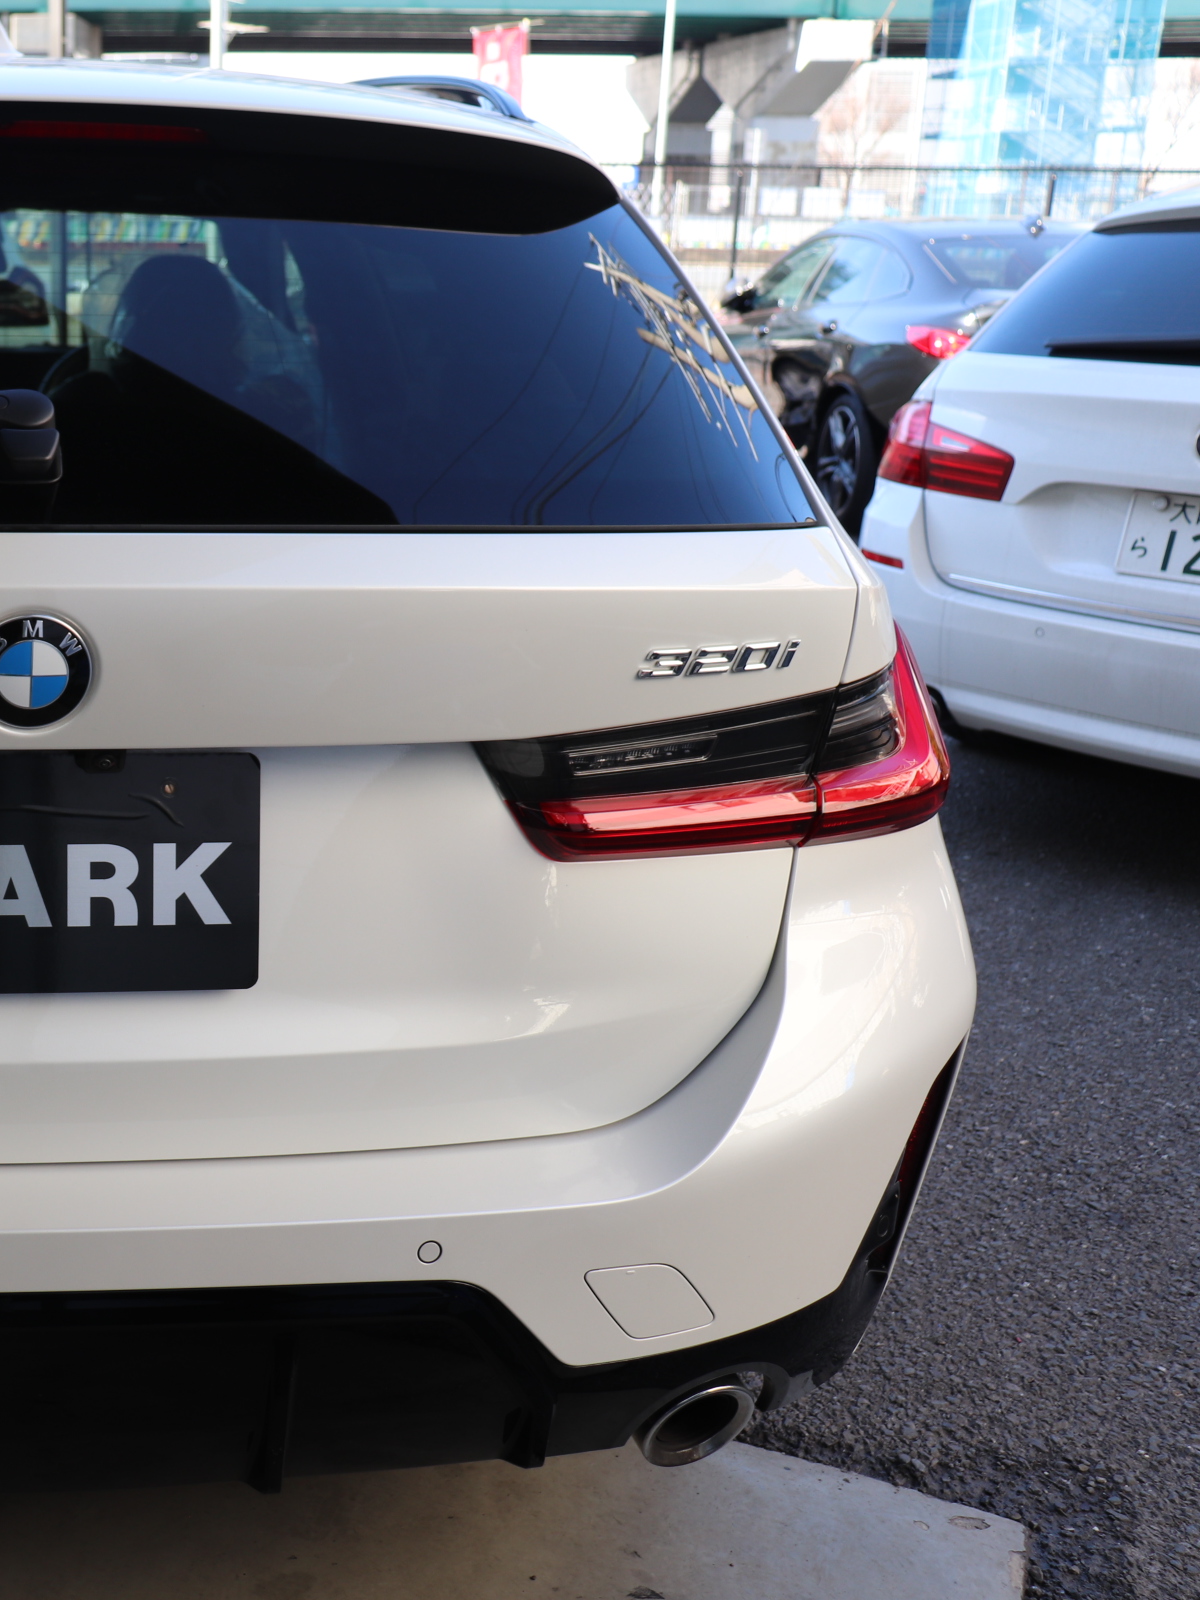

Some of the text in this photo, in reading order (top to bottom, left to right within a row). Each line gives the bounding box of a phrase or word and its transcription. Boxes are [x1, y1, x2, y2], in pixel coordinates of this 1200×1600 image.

[1169, 501, 1200, 525] 大
[1130, 529, 1200, 576] ら 12
[636, 639, 802, 678] 320i
